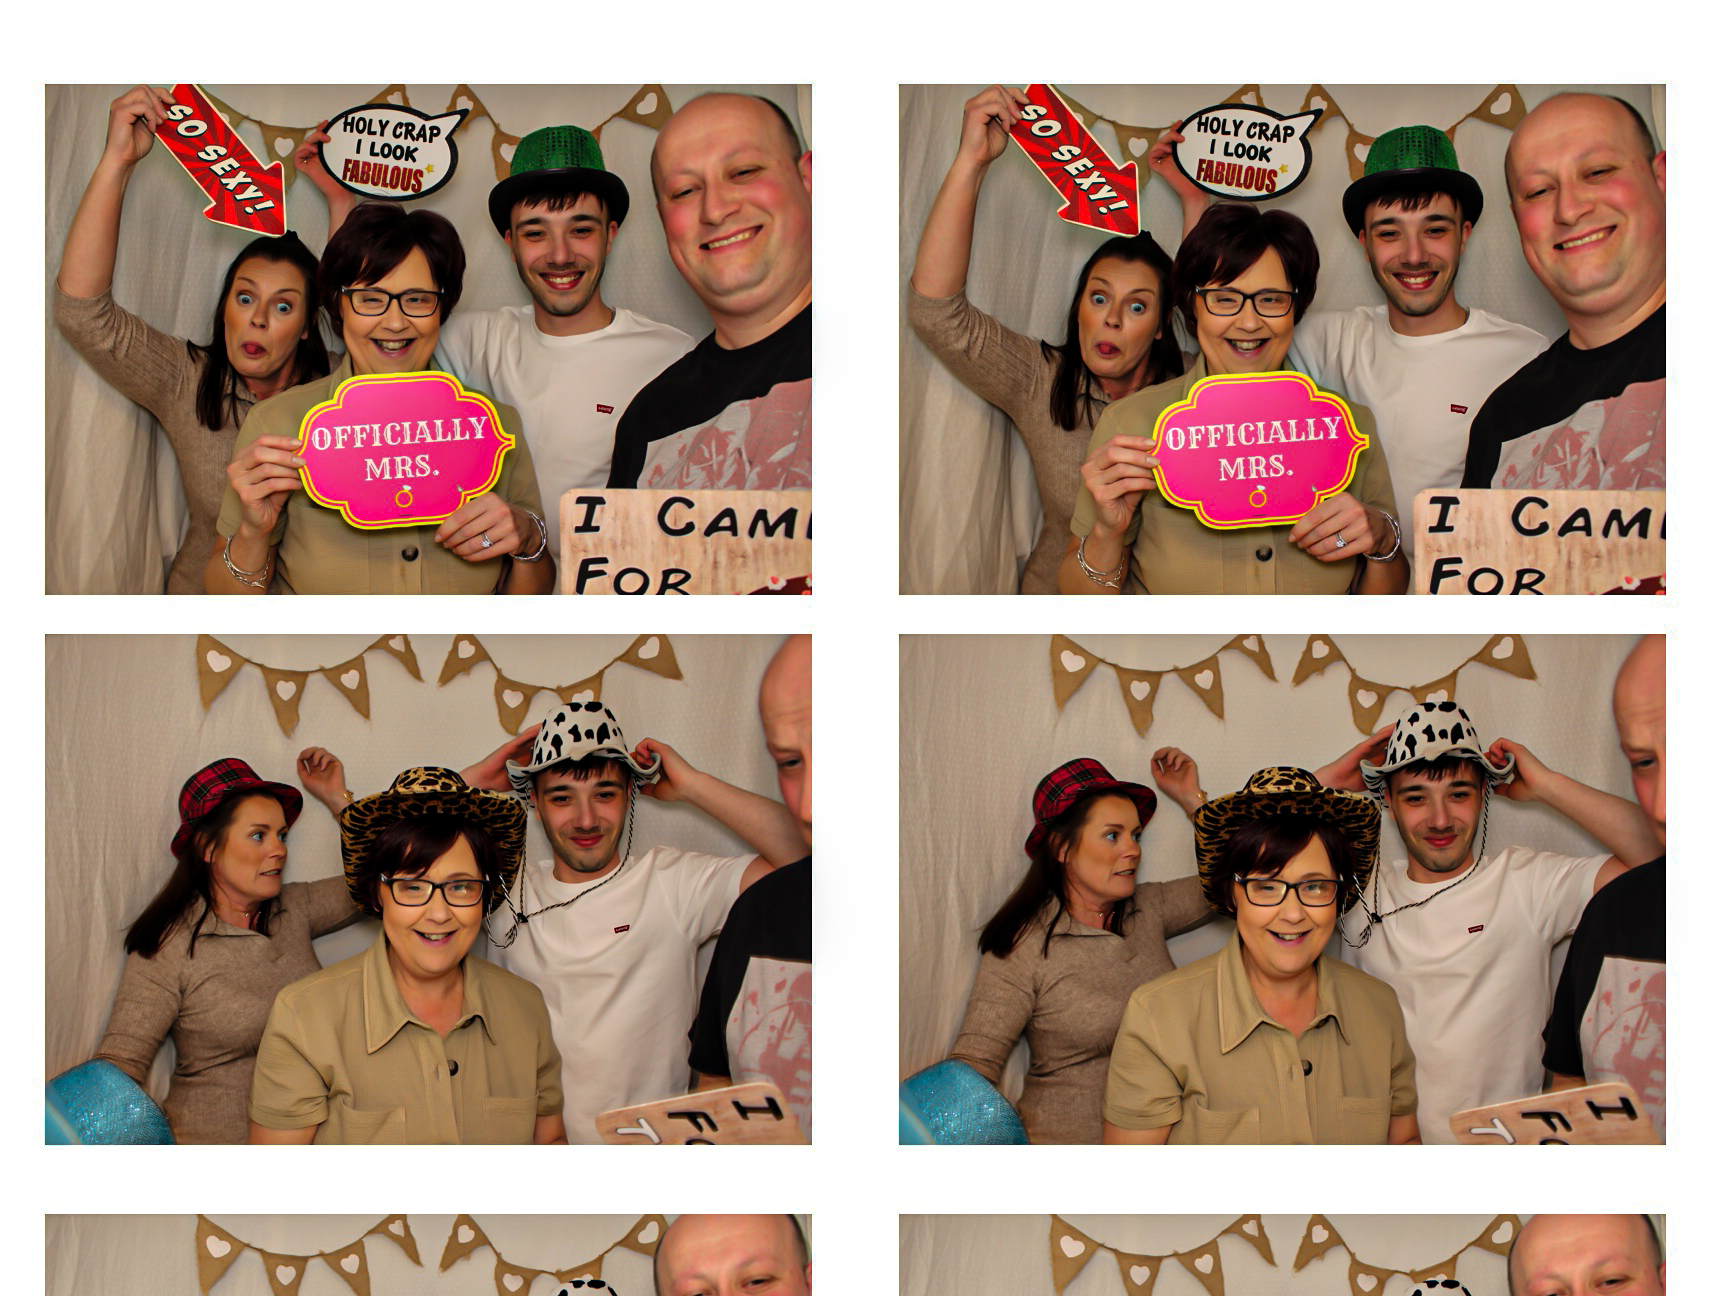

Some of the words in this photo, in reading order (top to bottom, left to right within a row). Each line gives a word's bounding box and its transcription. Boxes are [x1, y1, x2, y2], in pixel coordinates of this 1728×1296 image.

[343, 115, 390, 137] HOLY
[392, 122, 441, 143] CRAP
[1197, 115, 1244, 137] HOLY
[1246, 122, 1295, 143] CRAP
[166, 104, 208, 138] SO
[197, 145, 275, 215] SEXY!
[356, 138, 362, 155] I
[369, 141, 419, 163] LOOK
[1020, 104, 1062, 138] SO
[1051, 145, 1129, 215] SEXY!
[1210, 138, 1216, 155] I
[1223, 141, 1273, 163] LOOK
[342, 158, 424, 194] FABULOUS
[1196, 158, 1278, 194] FABULOUS
[311, 416, 488, 451] OFFICIALLY
[1165, 416, 1342, 451] OFFICIALLY
[364, 454, 440, 481] MRS.
[1218, 454, 1294, 481] MRS.
[574, 495, 606, 533] I
[657, 496, 812, 540] CAM
[1428, 495, 1460, 533] I
[1511, 496, 1666, 540] CAM
[575, 557, 692, 595] FOR
[1429, 557, 1546, 595] FOR
[667, 1111, 718, 1145] F
[1521, 1111, 1572, 1145] F
